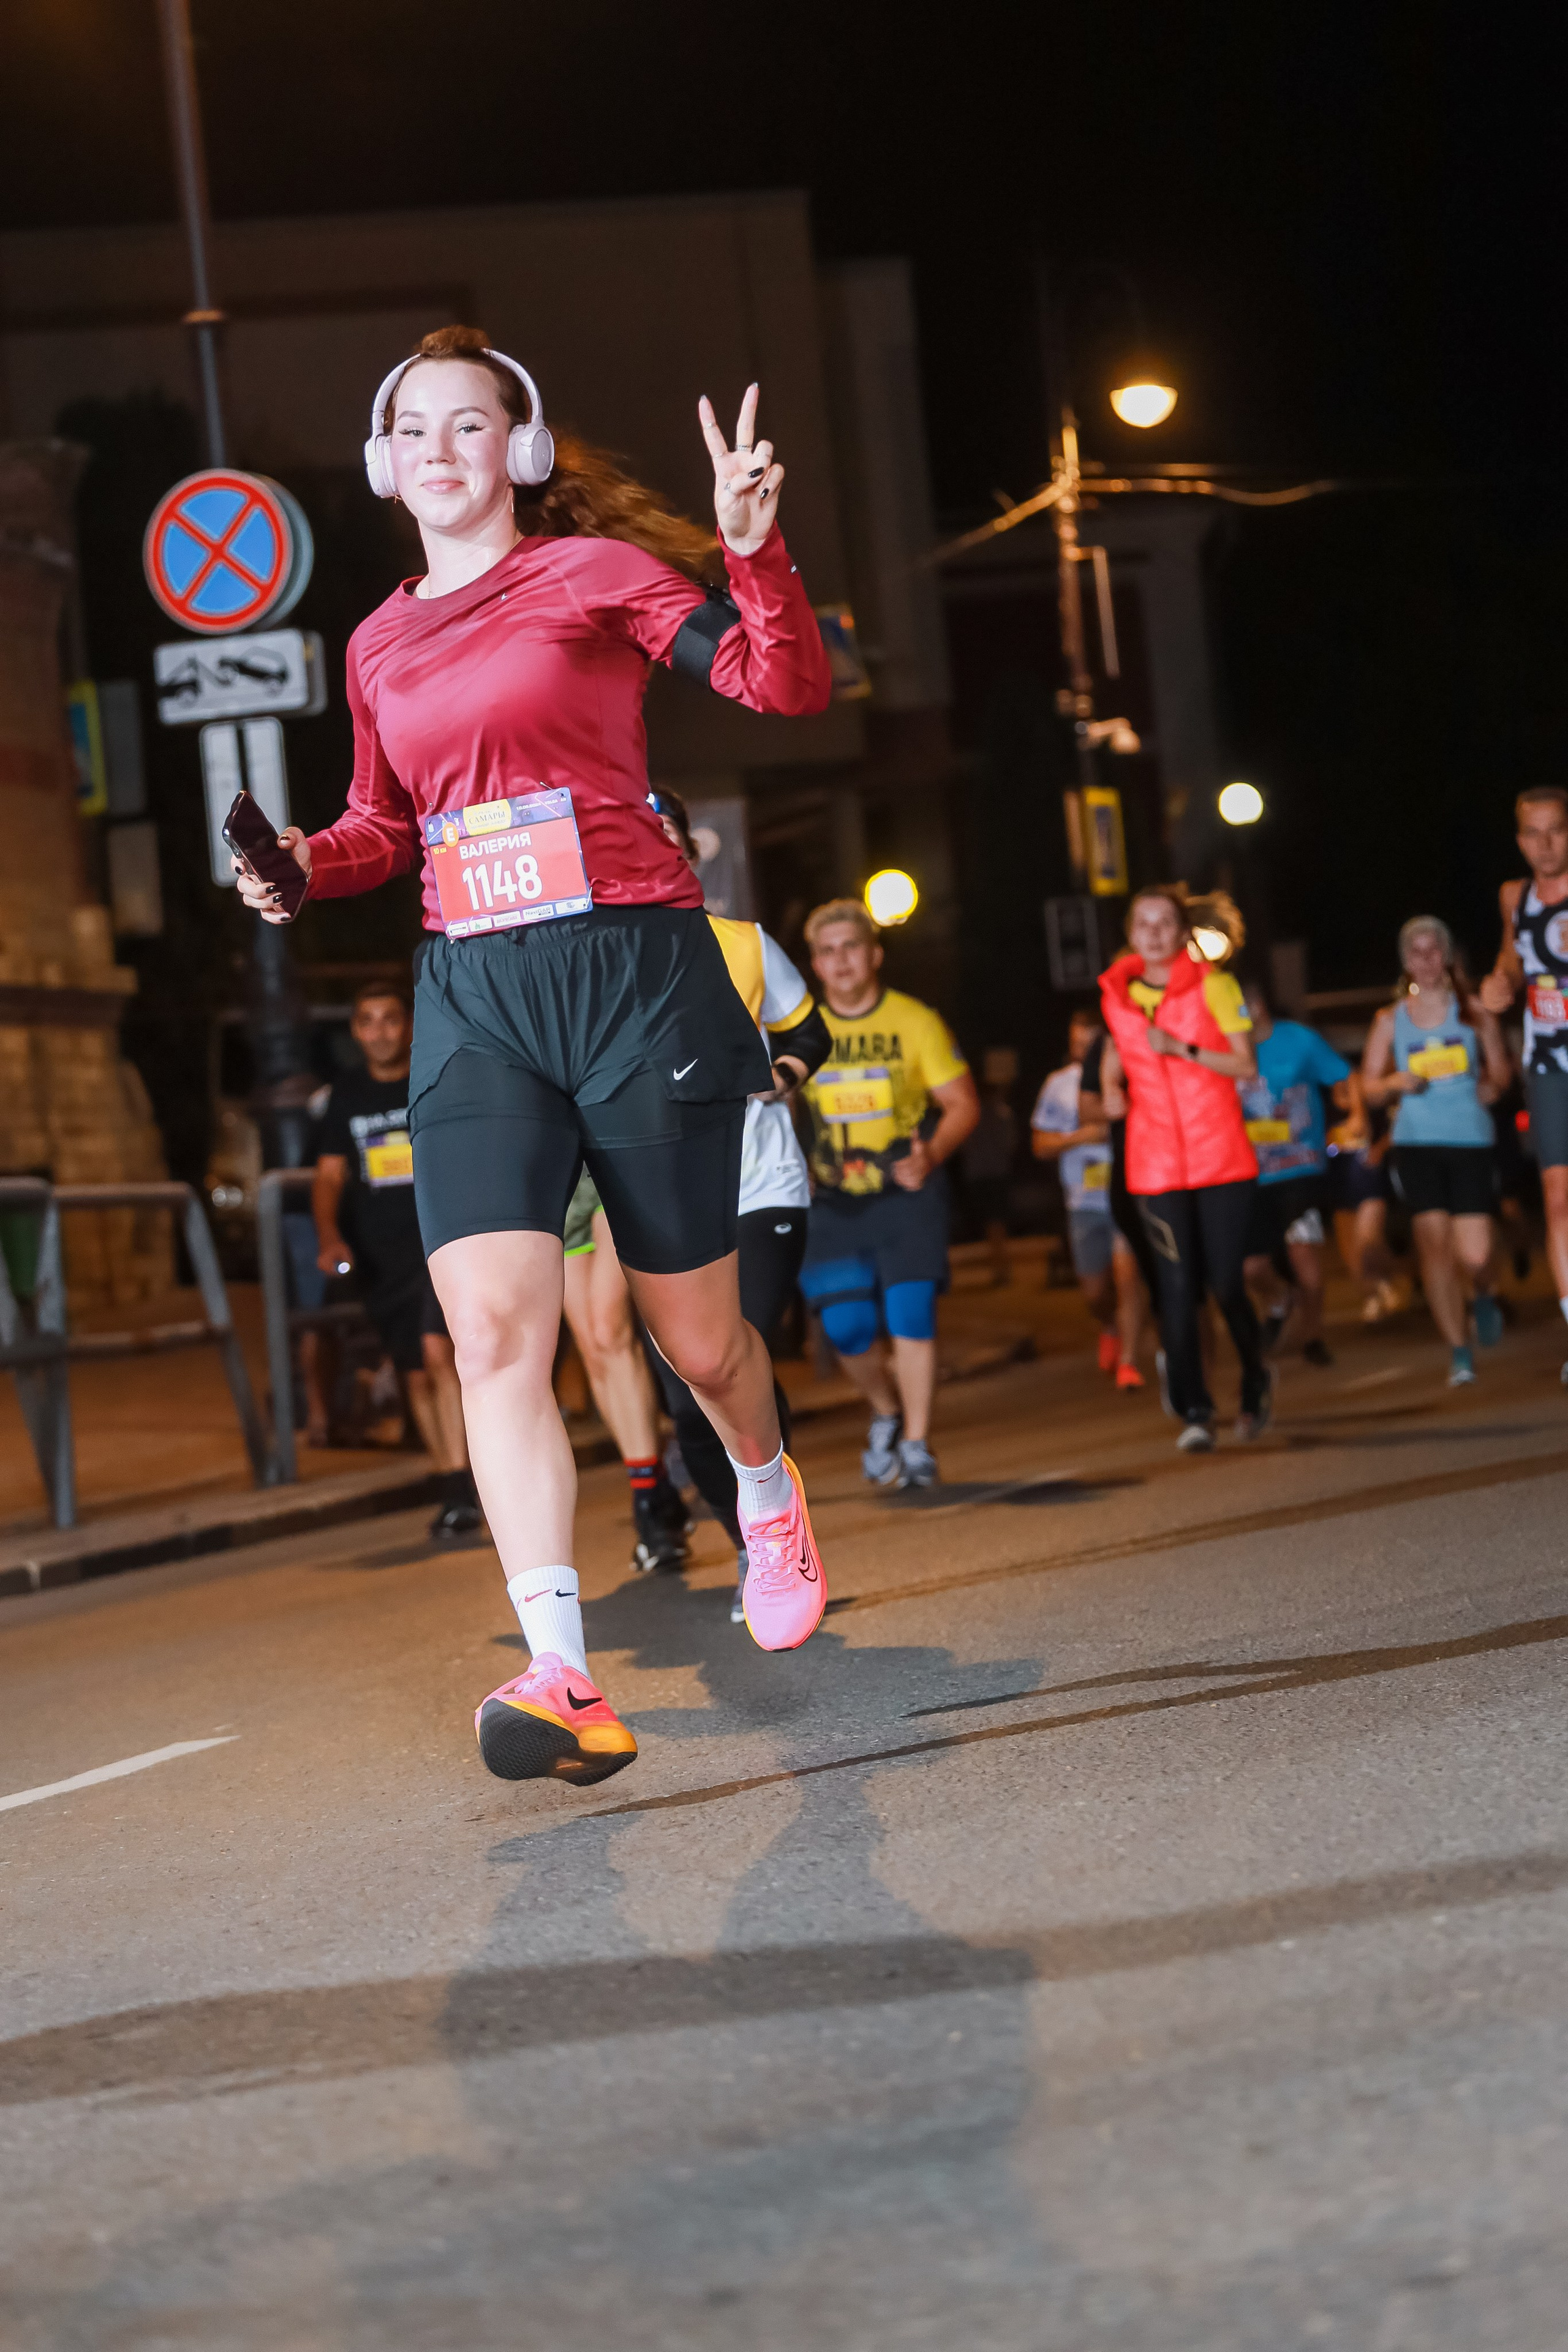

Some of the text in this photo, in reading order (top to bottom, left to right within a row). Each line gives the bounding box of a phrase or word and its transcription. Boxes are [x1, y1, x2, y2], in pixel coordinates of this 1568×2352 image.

[469, 811, 505, 824] САМАРЫ
[459, 832, 532, 859] ВАЛЕРИЯ
[462, 854, 543, 911] 1148
[829, 1033, 903, 1062] MARA
